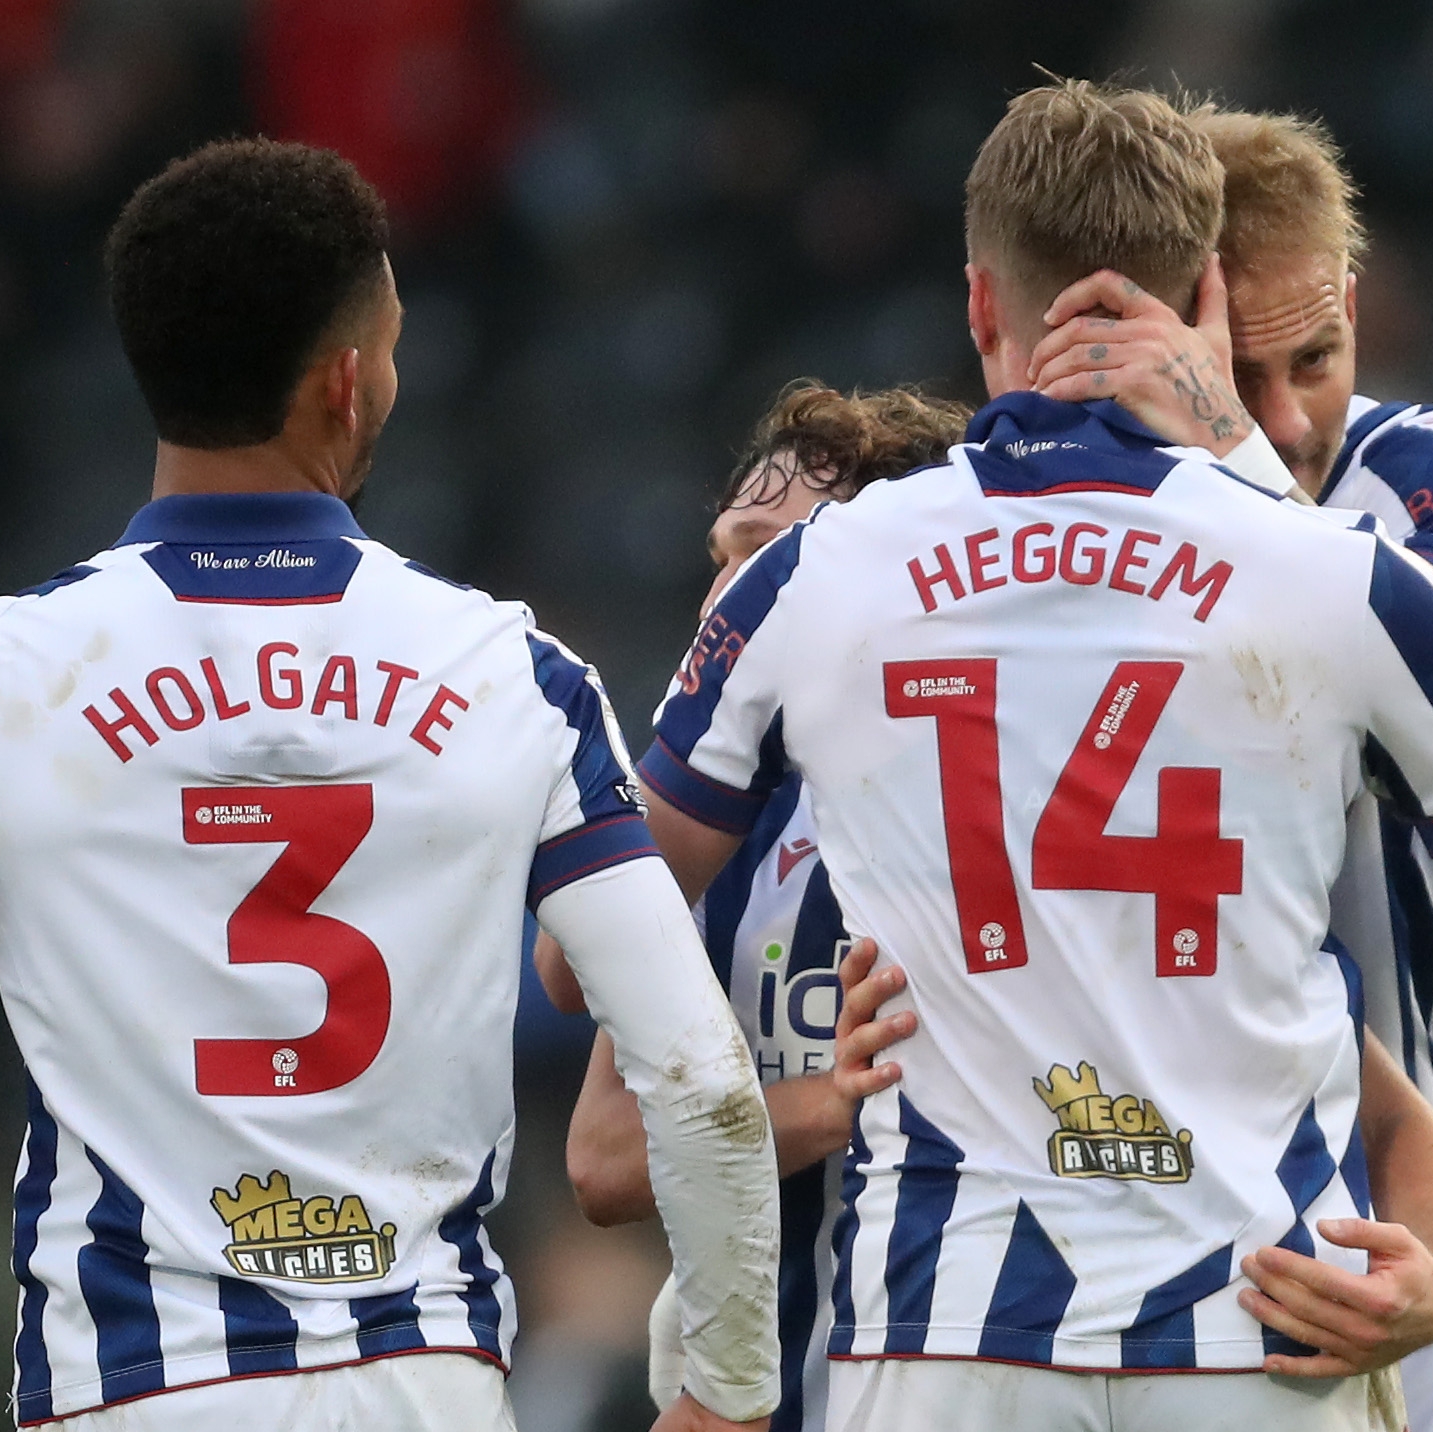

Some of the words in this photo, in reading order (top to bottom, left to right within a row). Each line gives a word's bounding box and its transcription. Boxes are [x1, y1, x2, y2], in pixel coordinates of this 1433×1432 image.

[190, 551, 223, 570] We
[223, 557, 251, 570] are
[254, 549, 317, 569] Albion
[907, 522, 1235, 624] HEGGEM
[920, 685, 976, 697] COMMUNITY
[936, 678, 947, 687] IN
[948, 676, 966, 686] THE
[82, 642, 473, 764] HOLGATE
[1108, 680, 1140, 735] COMMUNITY
[213, 805, 230, 815] EFL
[231, 805, 242, 814] IN
[243, 804, 262, 814] THE
[214, 813, 272, 824] COMMUNITY
[882, 657, 1244, 978] 14
[181, 782, 392, 1097] 3
[984, 949, 1007, 962] EFL
[1175, 955, 1197, 967] EFL
[274, 1075, 296, 1087] EFL
[1056, 1094, 1172, 1136] MEGA
[1062, 1140, 1180, 1176] RICHES
[232, 1196, 373, 1243] MEGA
[236, 1243, 374, 1278] RICHES
